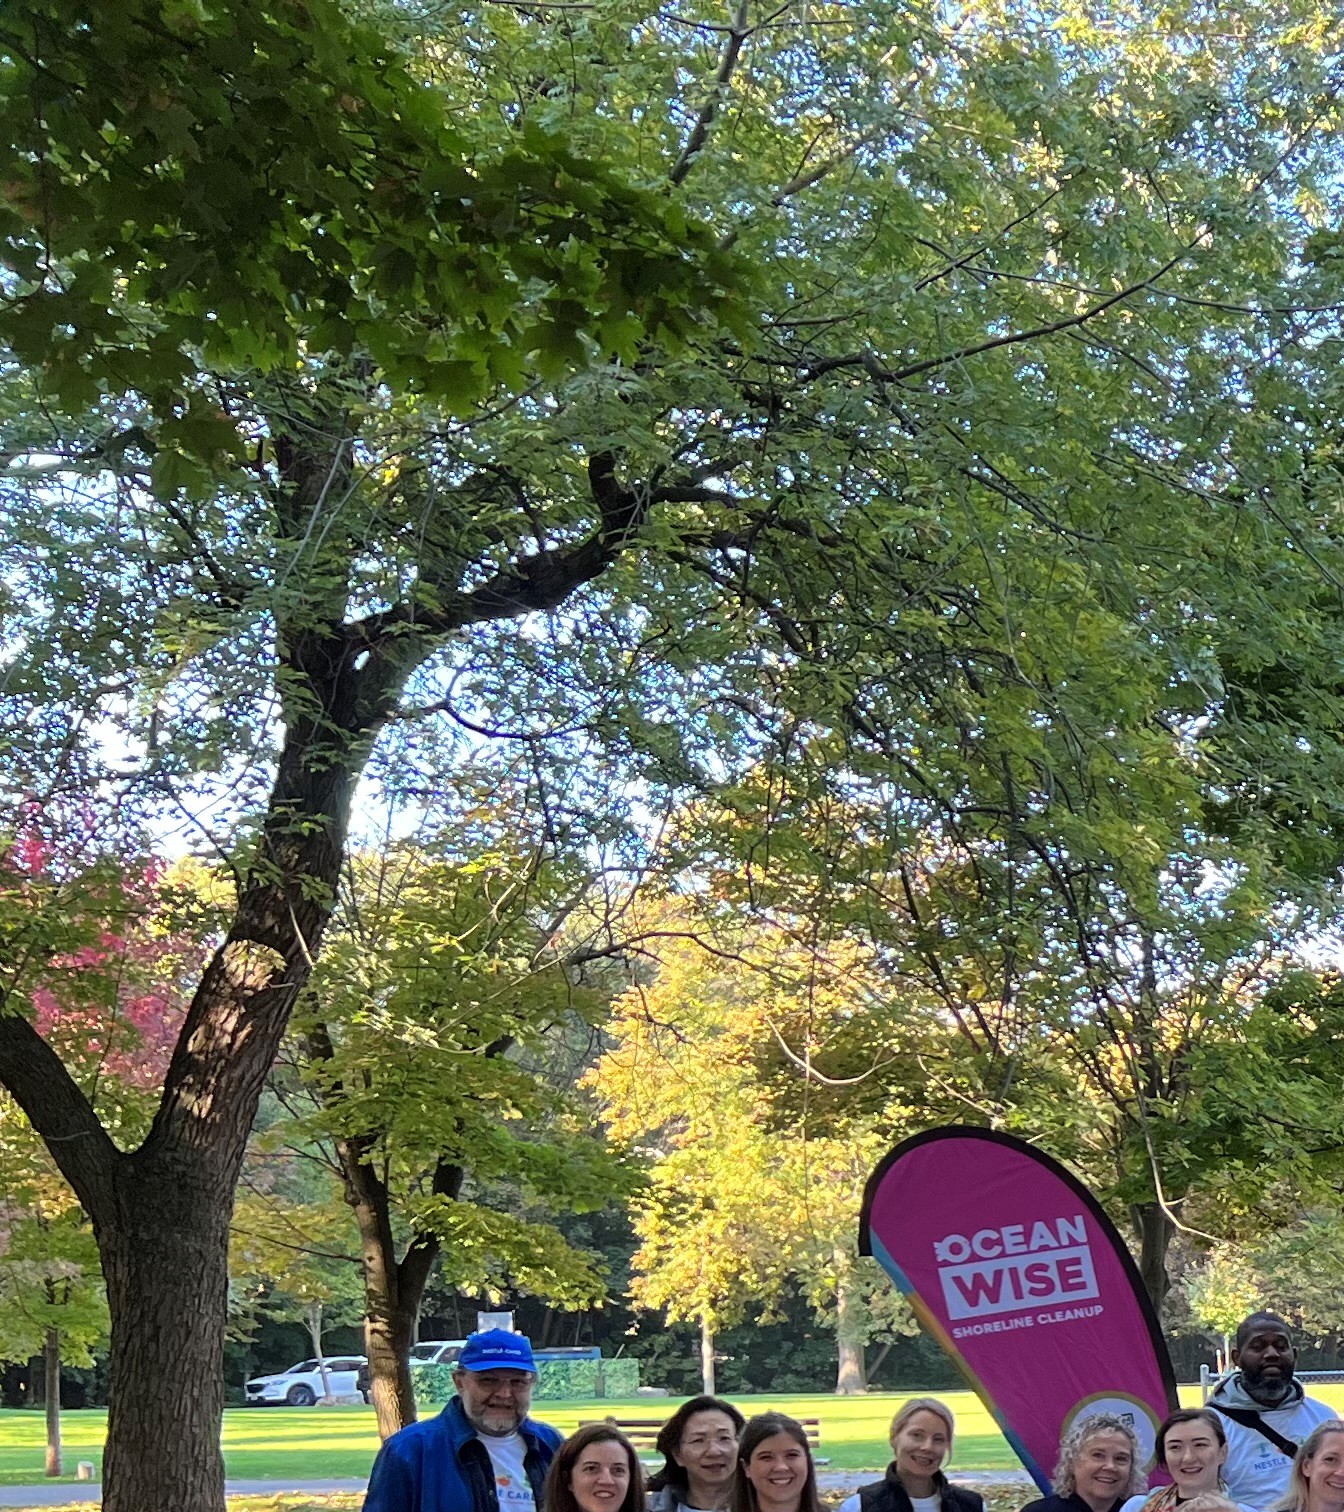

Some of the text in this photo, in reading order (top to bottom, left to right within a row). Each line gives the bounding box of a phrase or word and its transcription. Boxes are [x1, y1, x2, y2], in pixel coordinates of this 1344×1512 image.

[933, 1214, 1088, 1263] OCEAN
[951, 1256, 1087, 1308] WISE
[952, 1304, 1104, 1340] SHORELINE CLEANUP
[507, 1489, 535, 1501] CAR
